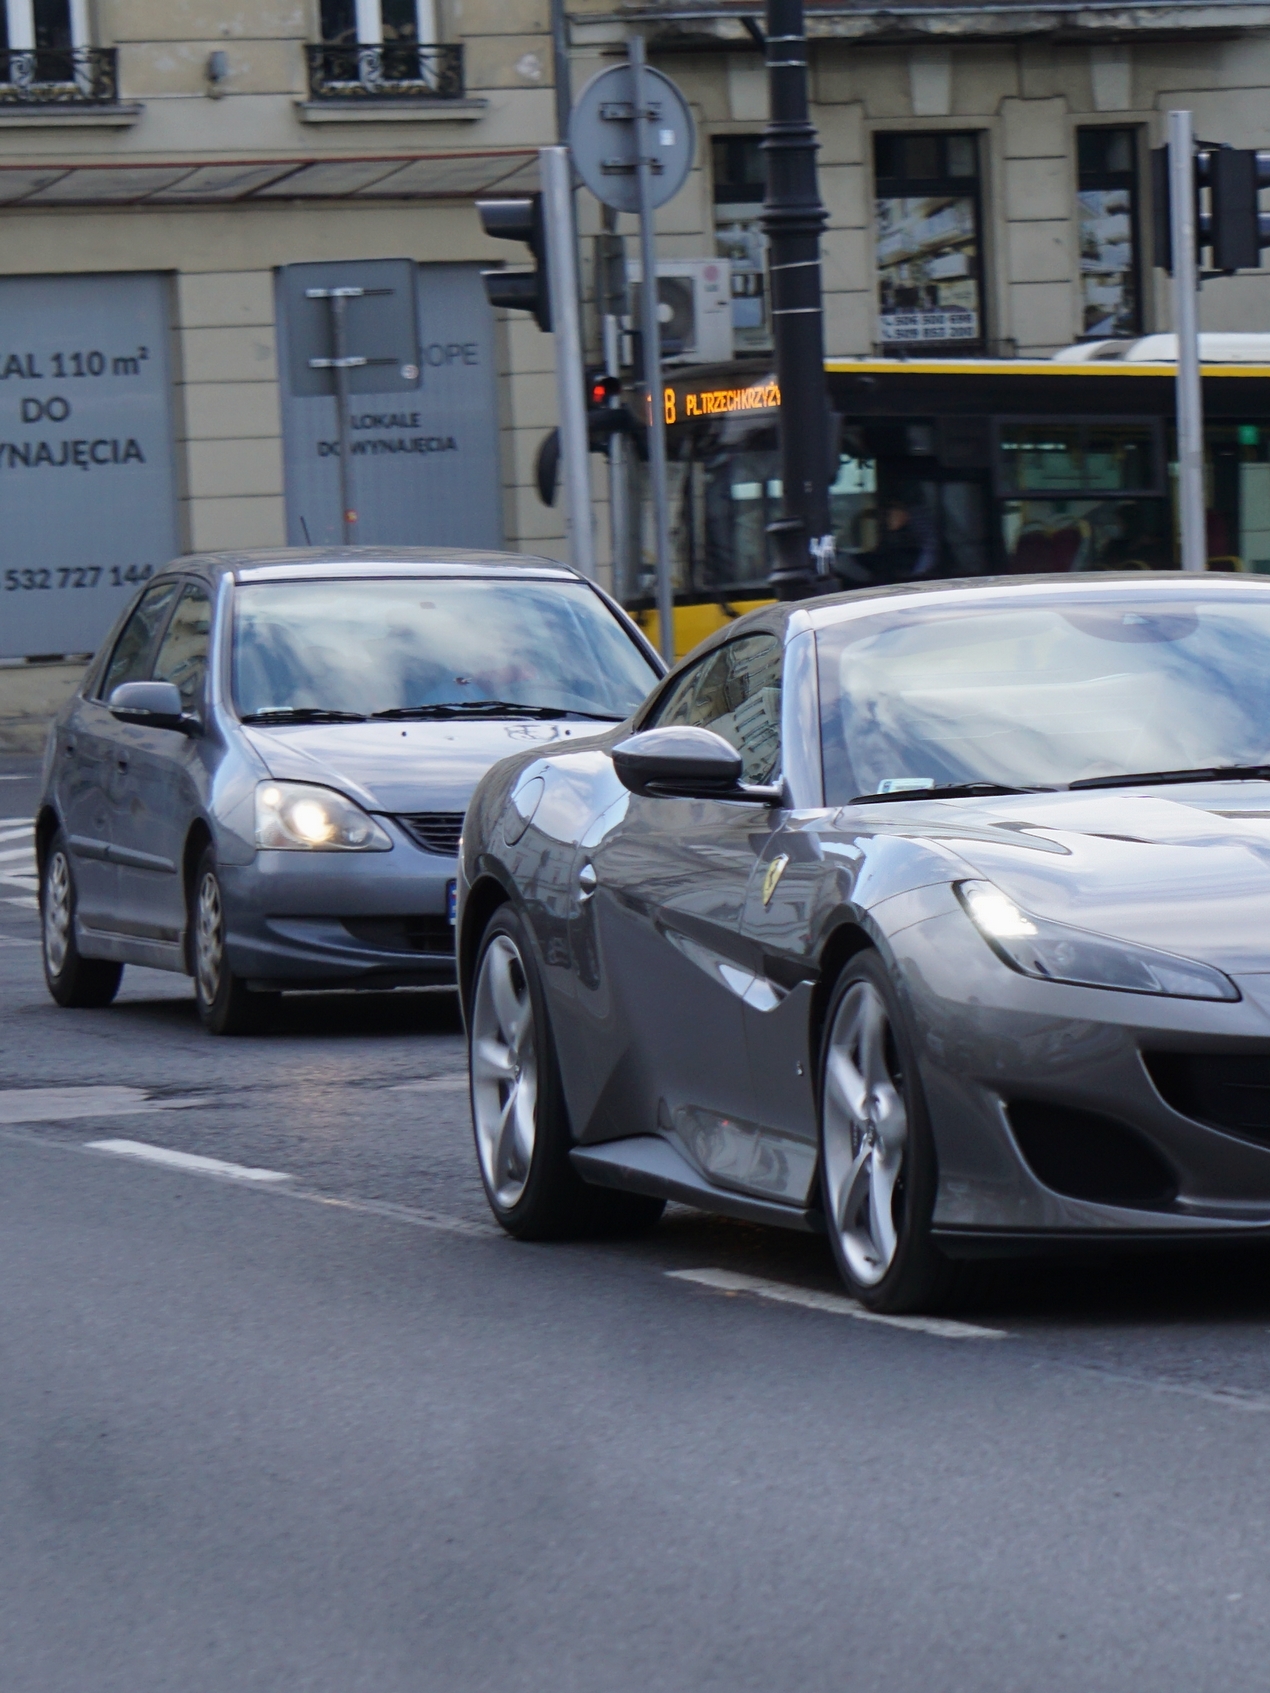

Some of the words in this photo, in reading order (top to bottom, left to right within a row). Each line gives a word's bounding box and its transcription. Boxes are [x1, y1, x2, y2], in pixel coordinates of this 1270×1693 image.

[51, 351, 106, 378] 110
[422, 343, 479, 367] OPE
[21, 397, 70, 424] DO
[351, 412, 422, 430] LOKALE
[4, 568, 52, 591] 532
[57, 566, 103, 589] 727
[109, 564, 154, 586] 144
